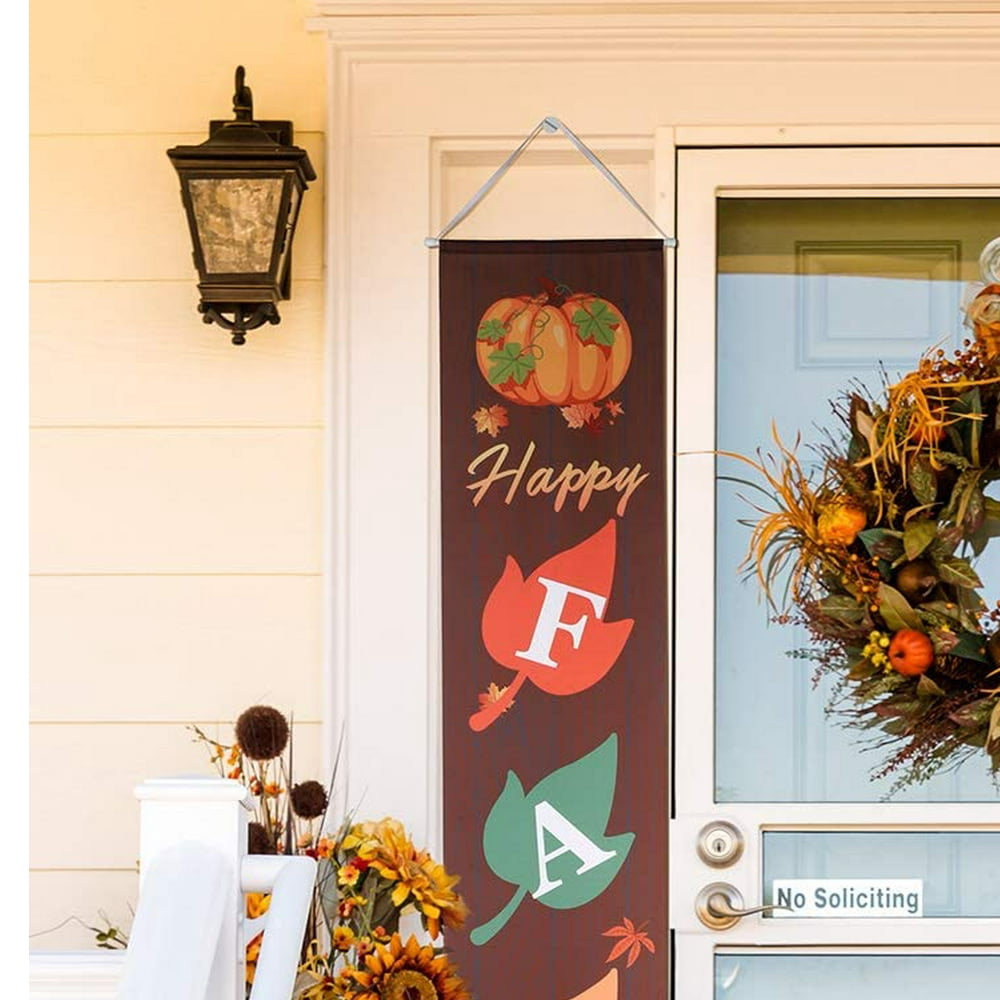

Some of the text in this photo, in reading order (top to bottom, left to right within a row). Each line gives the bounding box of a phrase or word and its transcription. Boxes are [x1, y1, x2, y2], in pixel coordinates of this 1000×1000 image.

[465, 440, 649, 517] Happy
[777, 887, 919, 914] No Soliciting
